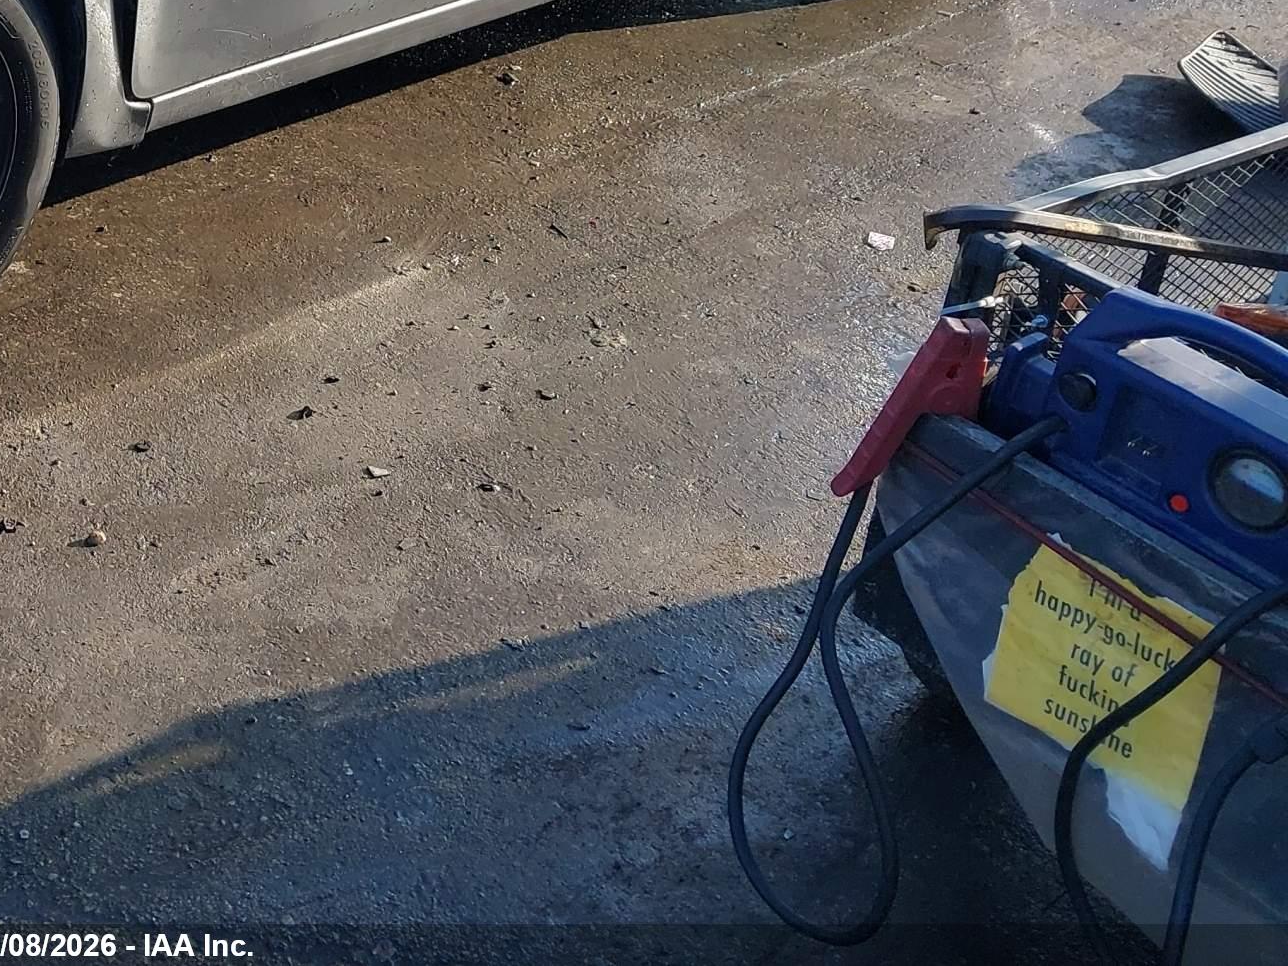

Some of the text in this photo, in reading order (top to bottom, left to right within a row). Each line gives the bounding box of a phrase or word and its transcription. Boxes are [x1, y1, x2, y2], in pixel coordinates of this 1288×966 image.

[1034, 580, 1177, 672] happy-go-luck
[1058, 664, 1129, 727] fuckin
[1070, 643, 1138, 687] ray of
[1044, 698, 1132, 758] sunsne
